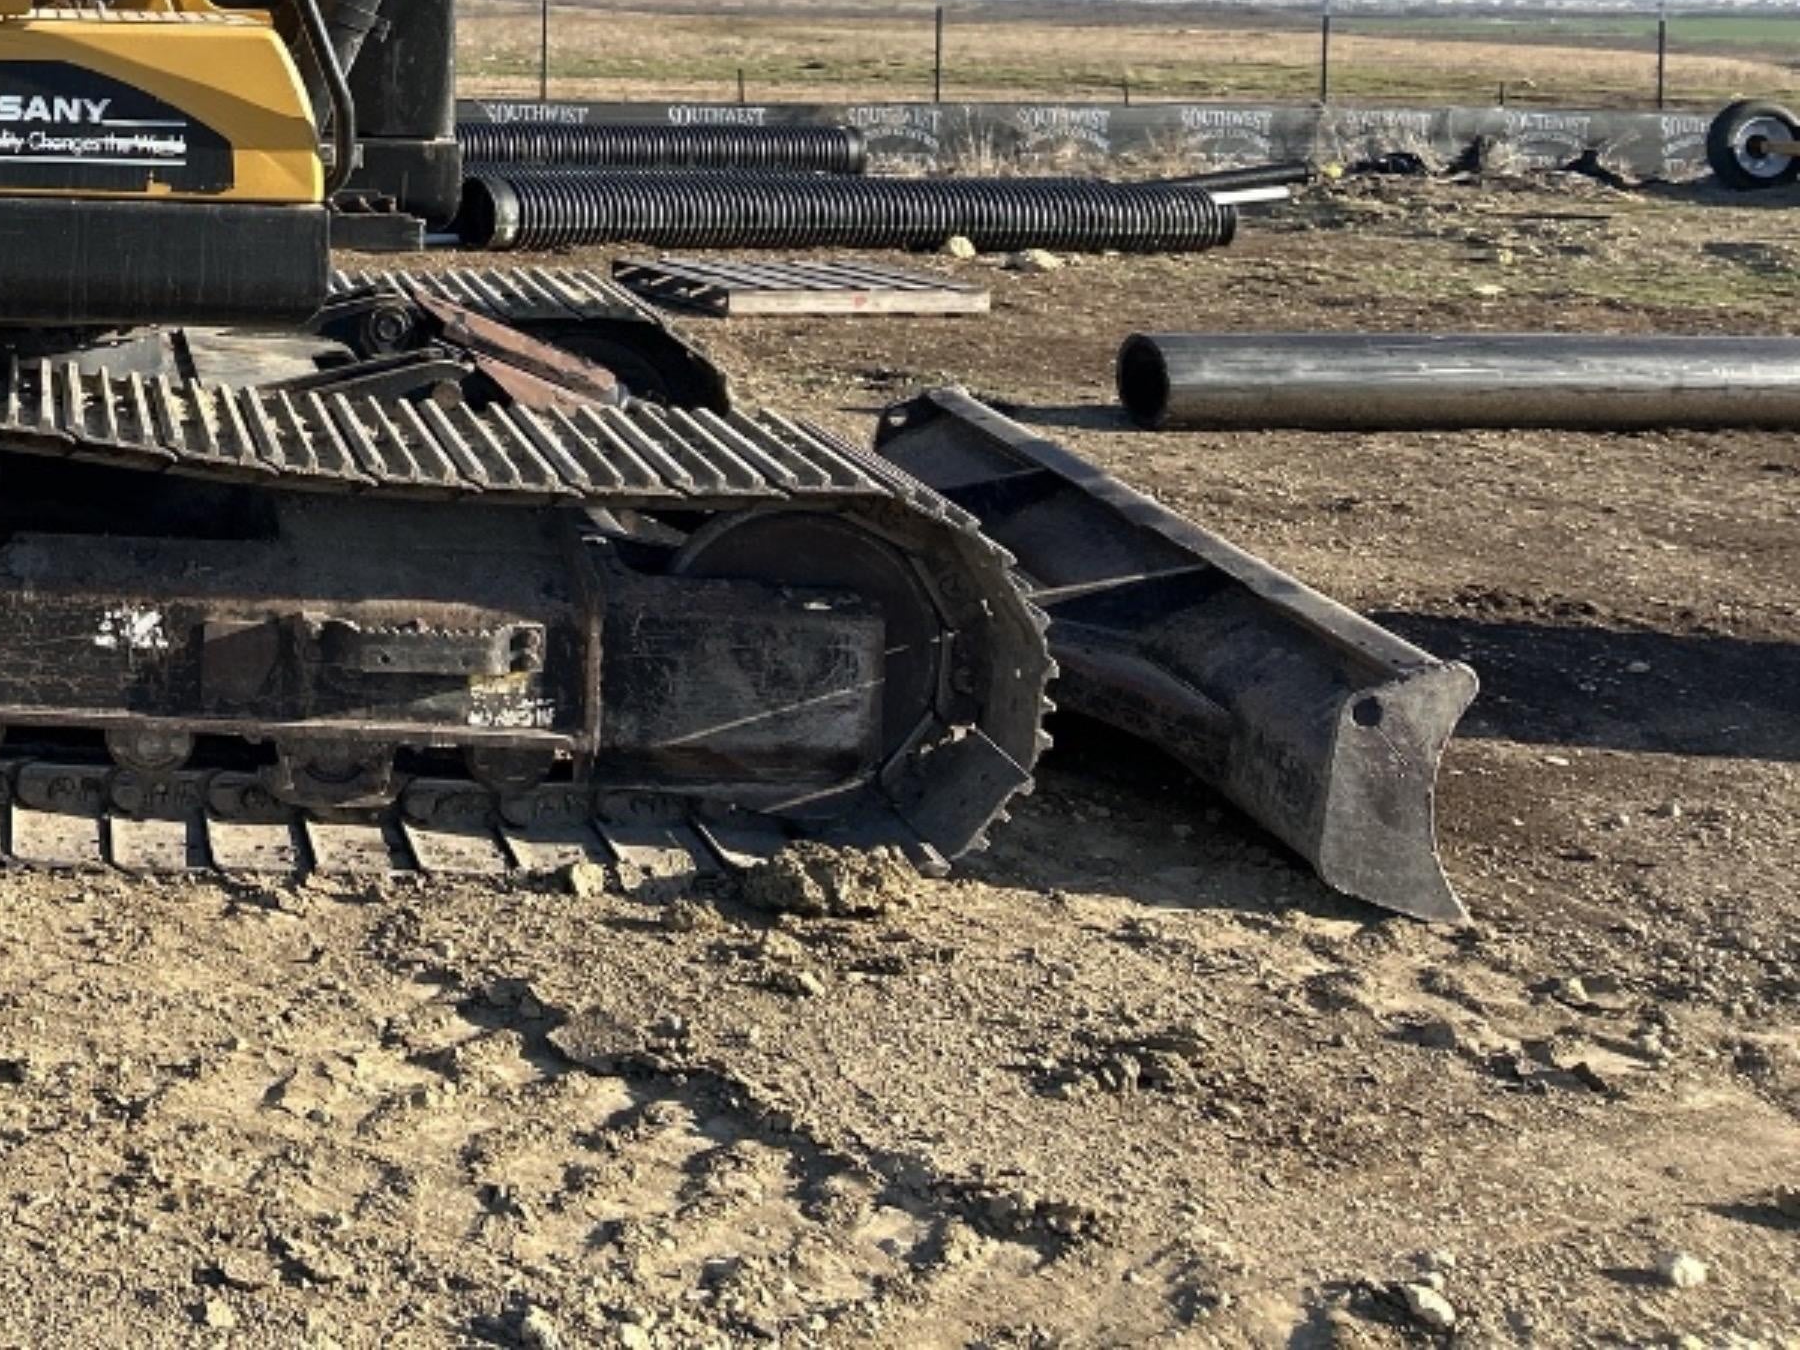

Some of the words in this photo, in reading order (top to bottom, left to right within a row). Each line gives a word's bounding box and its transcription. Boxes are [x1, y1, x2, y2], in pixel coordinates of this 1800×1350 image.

[485, 104, 589, 124] SOUTHWEST
[668, 105, 767, 126] SOUTHWEST
[1180, 107, 1273, 135] SOUTHWEST
